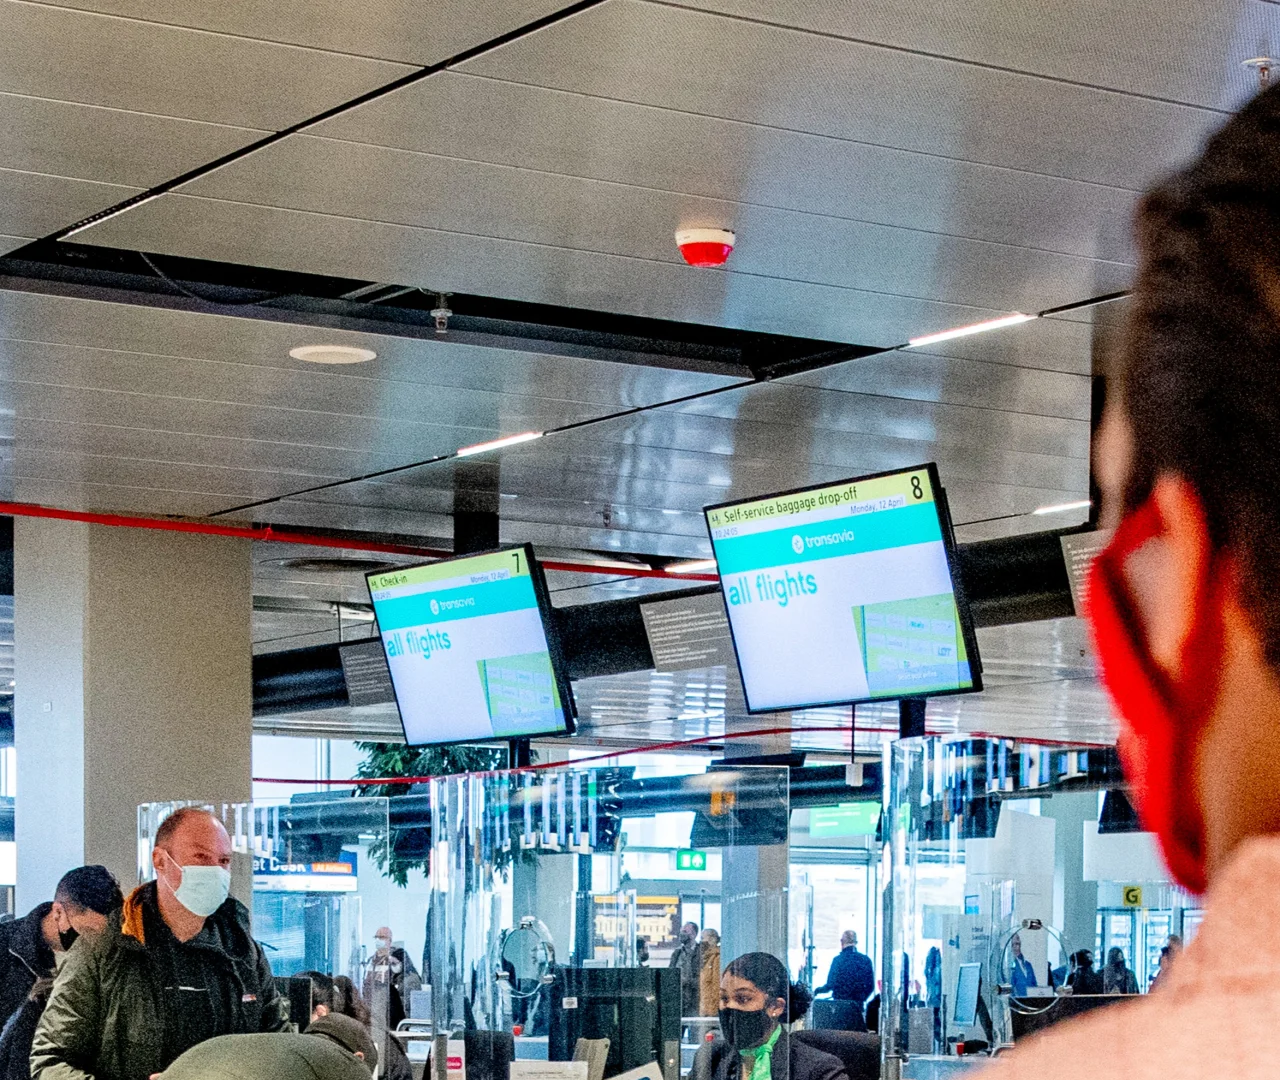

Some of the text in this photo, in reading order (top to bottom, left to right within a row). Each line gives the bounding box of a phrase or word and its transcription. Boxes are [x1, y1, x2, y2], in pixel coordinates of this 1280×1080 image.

[910, 475, 923, 500] 8
[724, 486, 858, 523] Self-service baggage drop-off
[850, 497, 904, 515] Monday, 12 April
[805, 530, 854, 548] transavia
[511, 552, 519, 573] 7
[380, 575, 408, 587] Check-in
[728, 570, 818, 607] all flights
[440, 597, 475, 610] transavia
[387, 628, 451, 659] all flights
[1126, 889, 1138, 904] G
